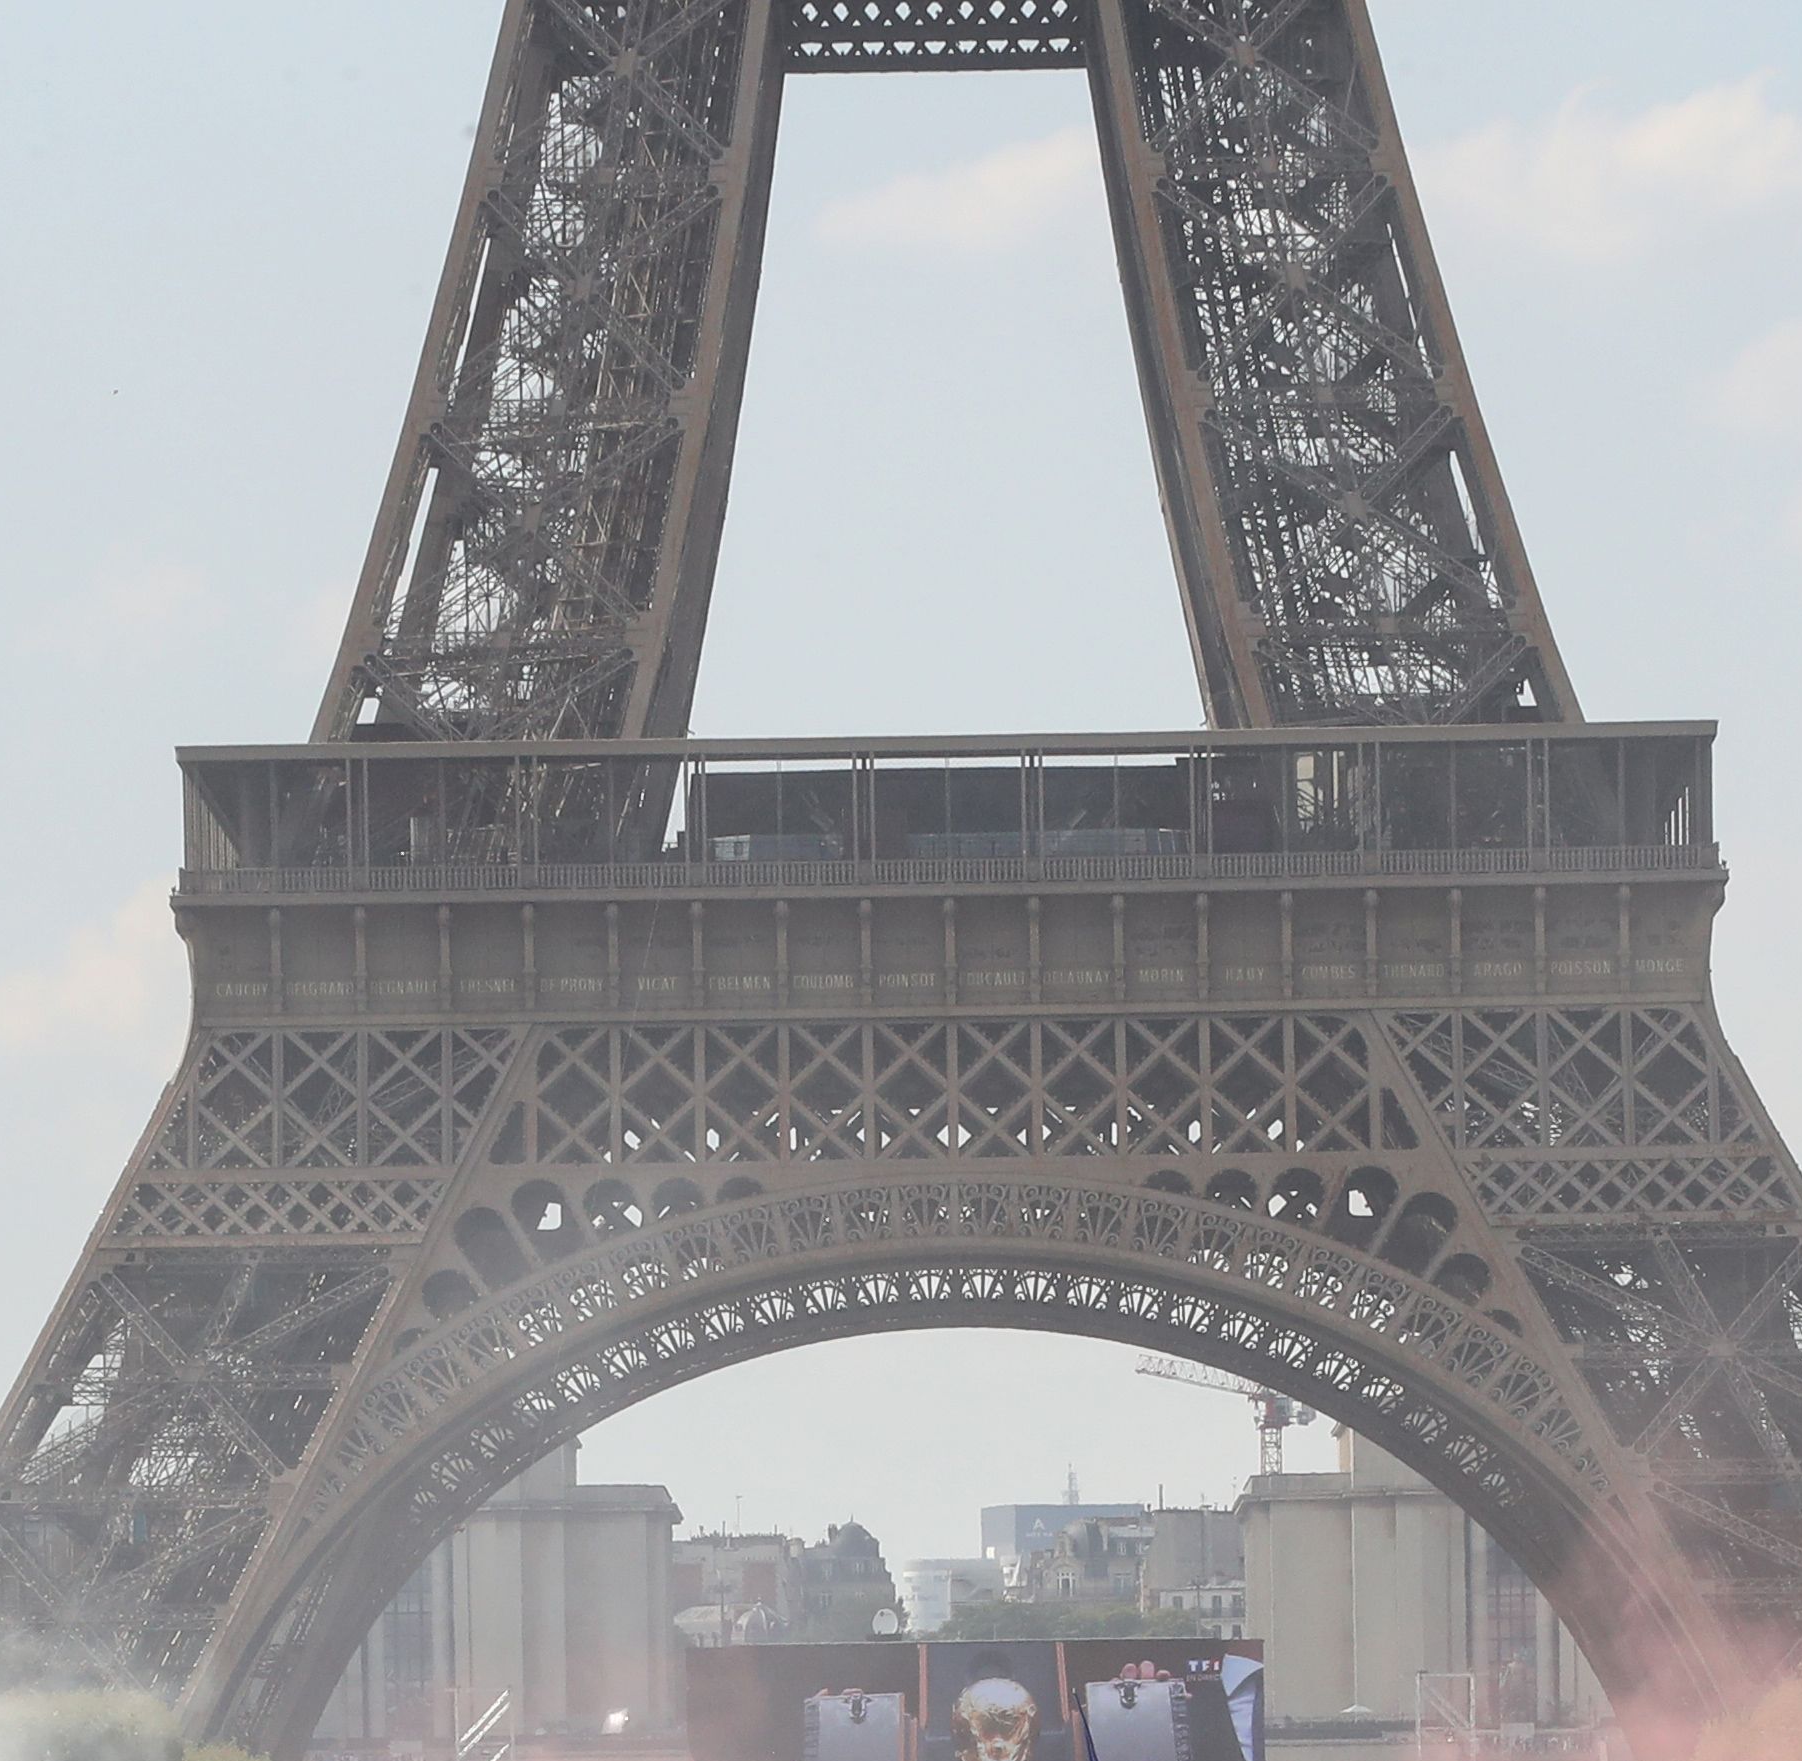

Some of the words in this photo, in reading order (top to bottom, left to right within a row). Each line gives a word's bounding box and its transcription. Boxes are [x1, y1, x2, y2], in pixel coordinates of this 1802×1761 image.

[1551, 960, 1611, 975] POISSON
[1636, 958, 1684, 973] MONGE
[1139, 968, 1184, 983] MORIN
[216, 983, 269, 996] CAUCHY
[560, 978, 605, 992] PRONY
[637, 976, 678, 991] VICAT
